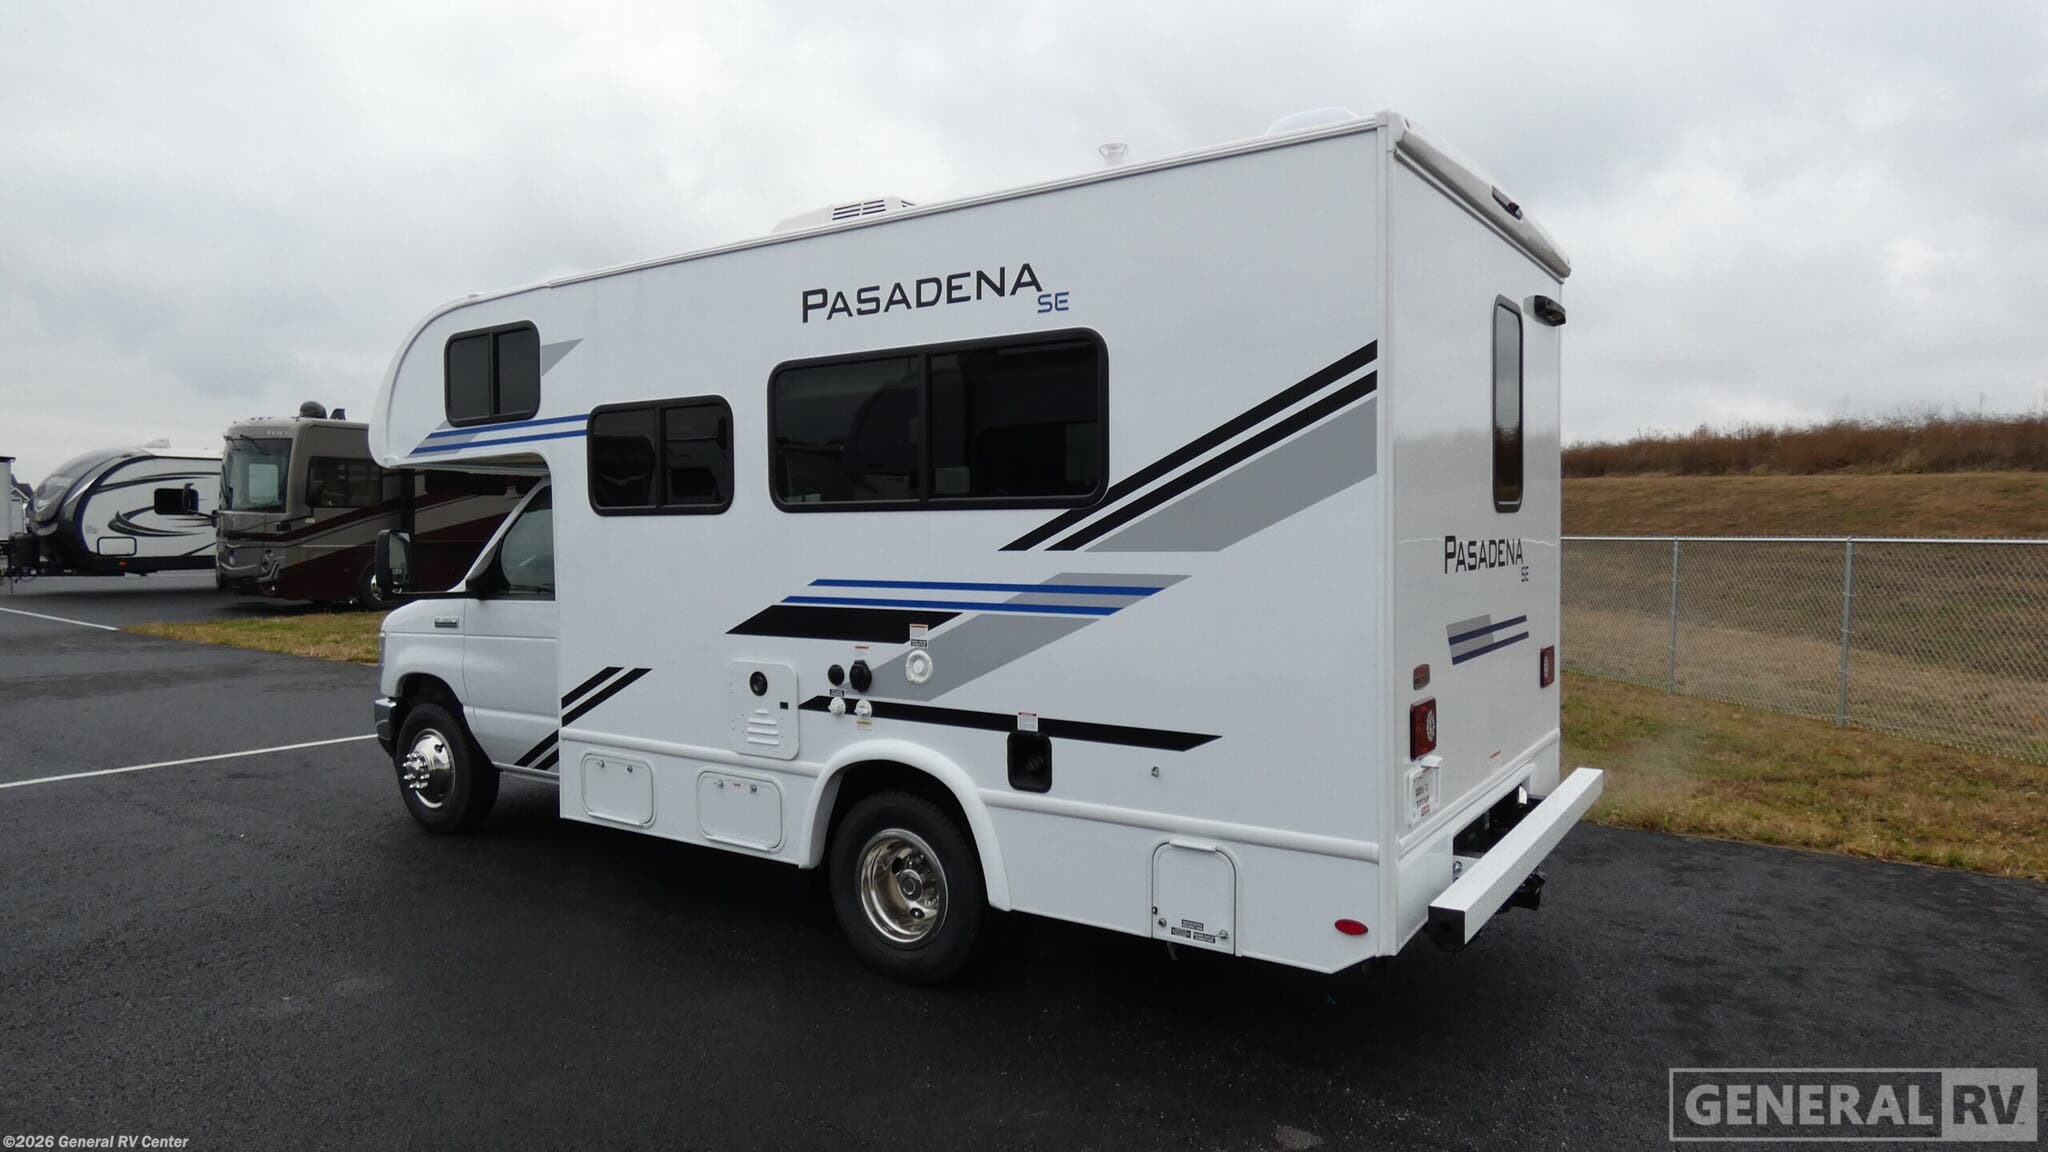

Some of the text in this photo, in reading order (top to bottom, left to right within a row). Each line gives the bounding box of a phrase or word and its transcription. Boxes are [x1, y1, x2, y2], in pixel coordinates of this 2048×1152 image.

[802, 263, 1043, 323] PASADENA
[1037, 291, 1070, 314] SE
[1445, 535, 1524, 575] PASADENA
